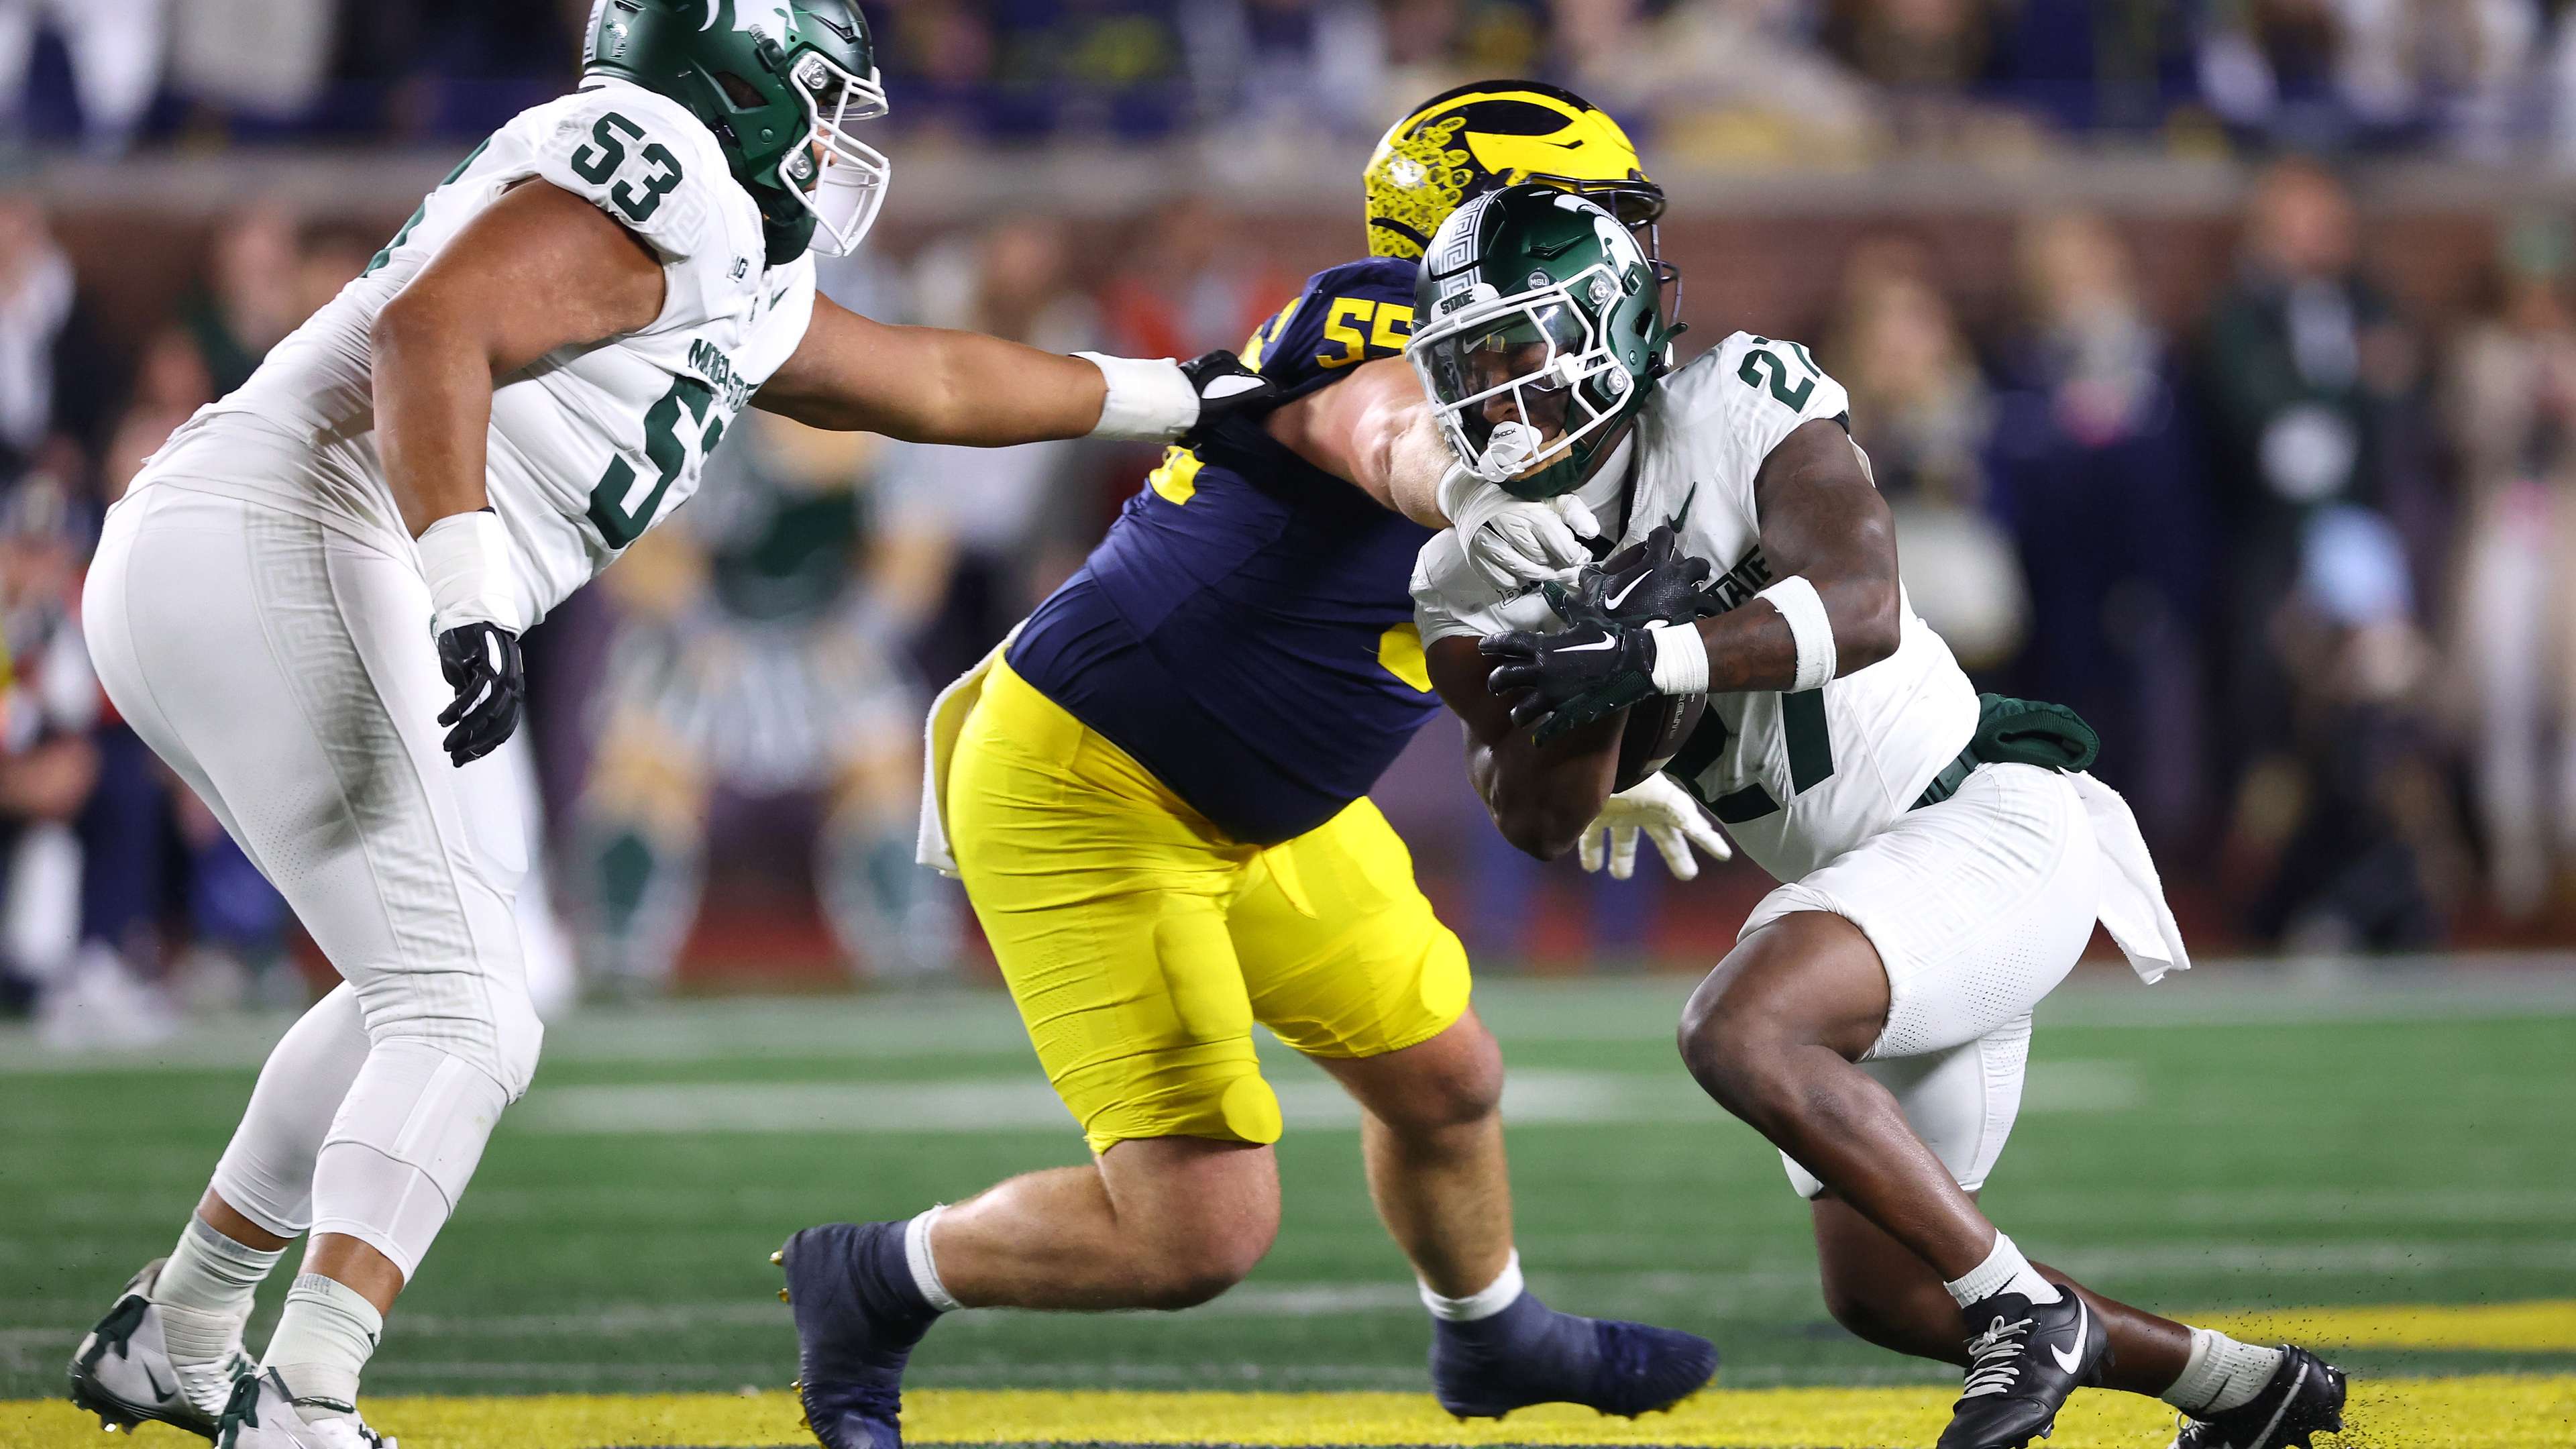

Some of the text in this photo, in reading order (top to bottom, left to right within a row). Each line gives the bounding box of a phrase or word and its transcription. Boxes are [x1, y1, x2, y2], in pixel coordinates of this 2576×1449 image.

[571, 111, 683, 222] 53
[1440, 288, 1476, 315] STATE
[1529, 278, 1548, 286] MSU
[1316, 297, 1414, 369] 55
[1494, 427, 1516, 439] SHOCK
[1699, 543, 1773, 612] TATE
